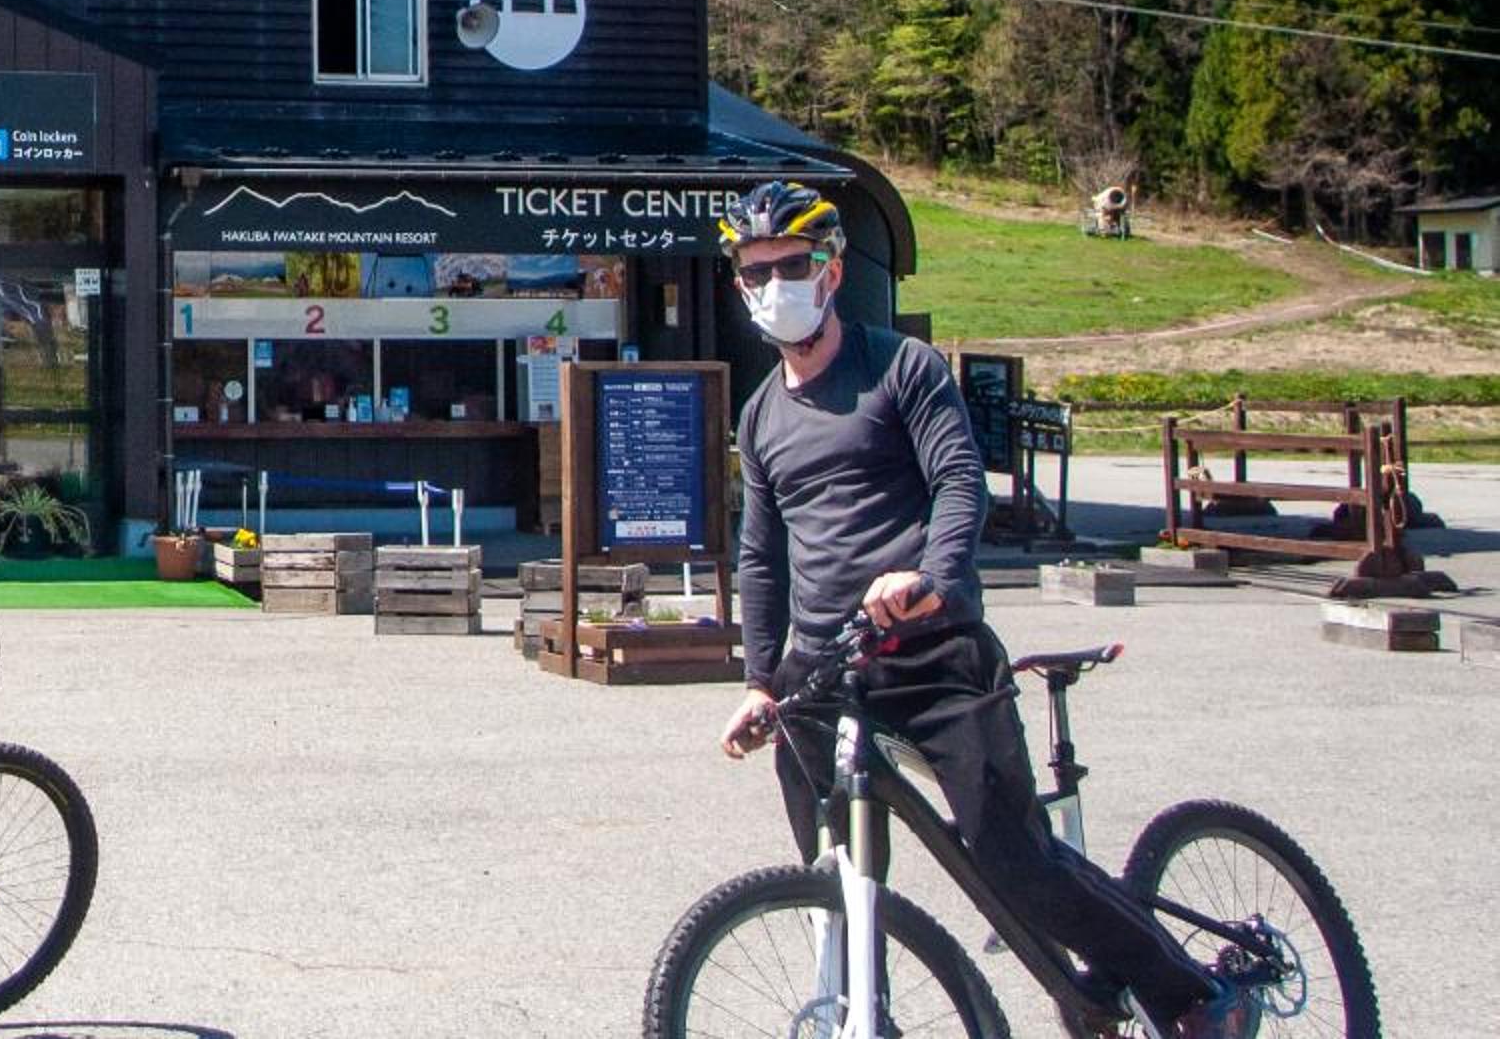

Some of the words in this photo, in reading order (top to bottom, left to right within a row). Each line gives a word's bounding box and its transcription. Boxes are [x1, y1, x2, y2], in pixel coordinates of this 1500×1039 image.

[12, 130, 36, 143] Coin
[39, 130, 77, 144] lockers
[13, 147, 83, 159] コインロッカー
[496, 187, 608, 217] TICKET
[221, 230, 271, 243] HAKUBA
[273, 231, 325, 243] IWATAKE
[328, 232, 392, 244] MOUNTAIN
[395, 232, 438, 244] RESORT
[541, 228, 697, 249] チケットセンター
[179, 305, 193, 335] 1
[304, 305, 326, 335] 2
[428, 305, 450, 336] 3
[545, 308, 568, 336] 4
